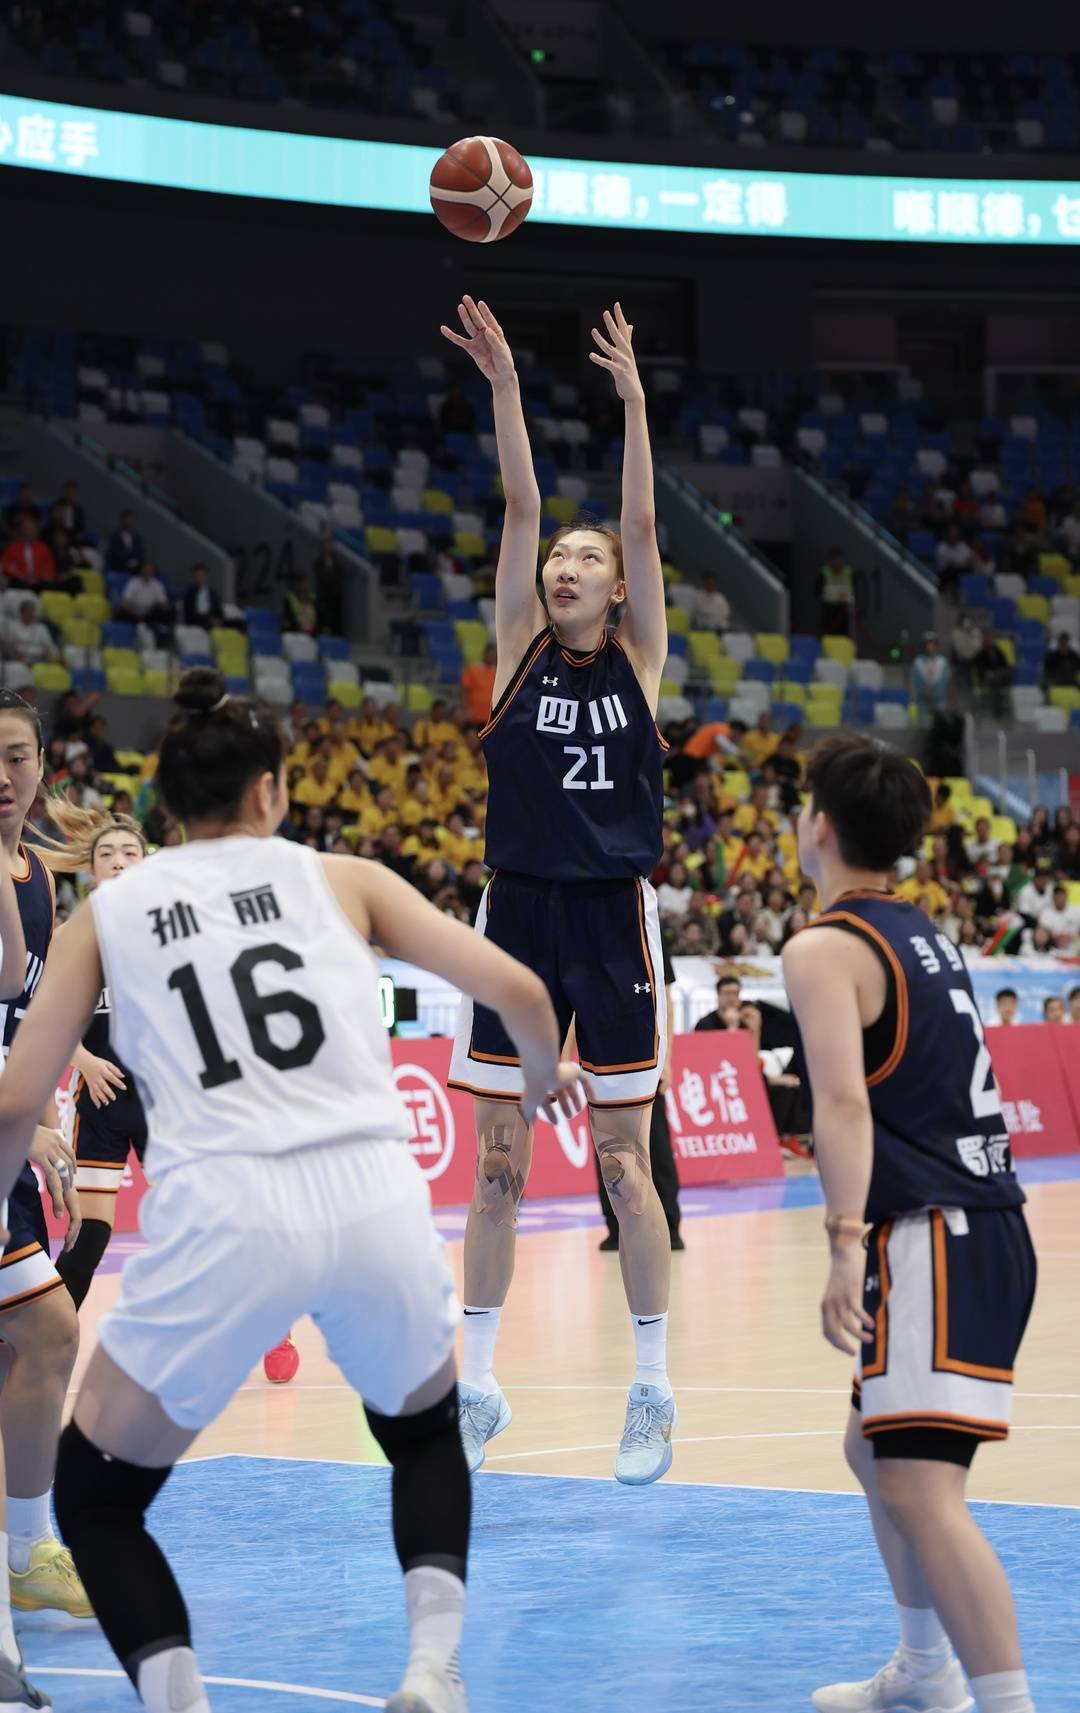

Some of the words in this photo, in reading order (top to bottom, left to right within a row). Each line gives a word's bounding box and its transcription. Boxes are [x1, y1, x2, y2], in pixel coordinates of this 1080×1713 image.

[536, 694, 628, 735] 四川
[562, 745, 614, 790] 21
[167, 942, 326, 1089] 16
[664, 1059, 749, 1134] 电信
[676, 1132, 758, 1159] TELECOM
